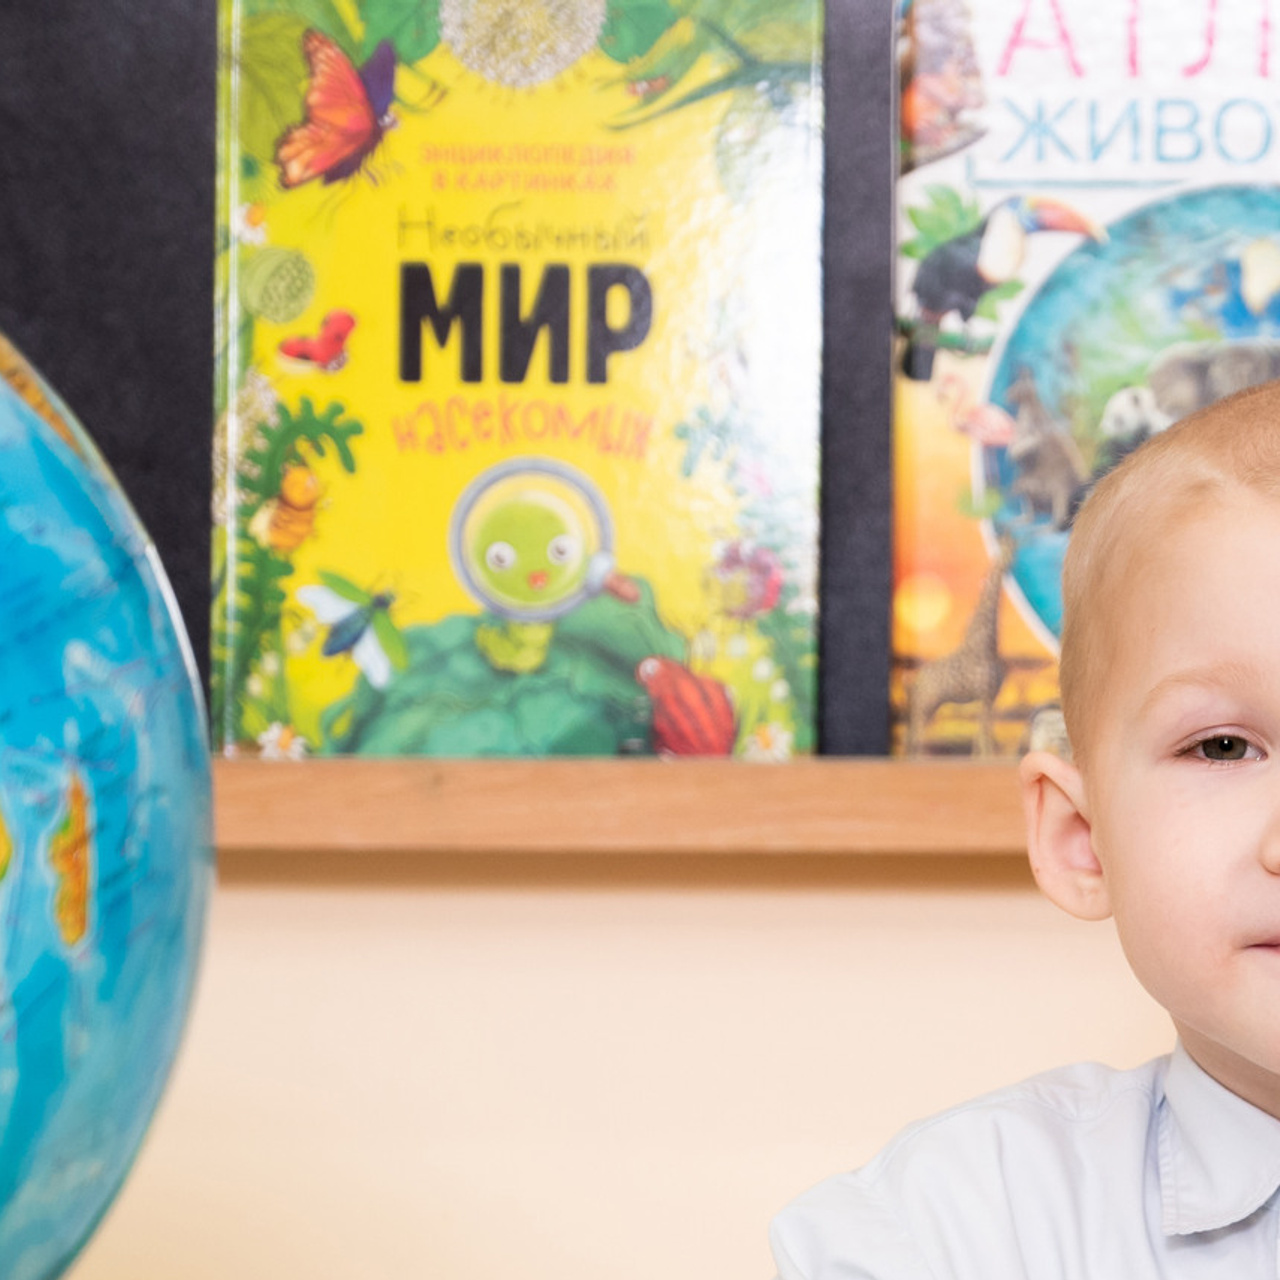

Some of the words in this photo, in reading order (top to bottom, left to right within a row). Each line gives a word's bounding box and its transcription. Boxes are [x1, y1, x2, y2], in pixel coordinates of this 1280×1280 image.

[397, 199, 651, 253] Необычный
[399, 262, 653, 385] МИР
[391, 392, 652, 459] насекомых
